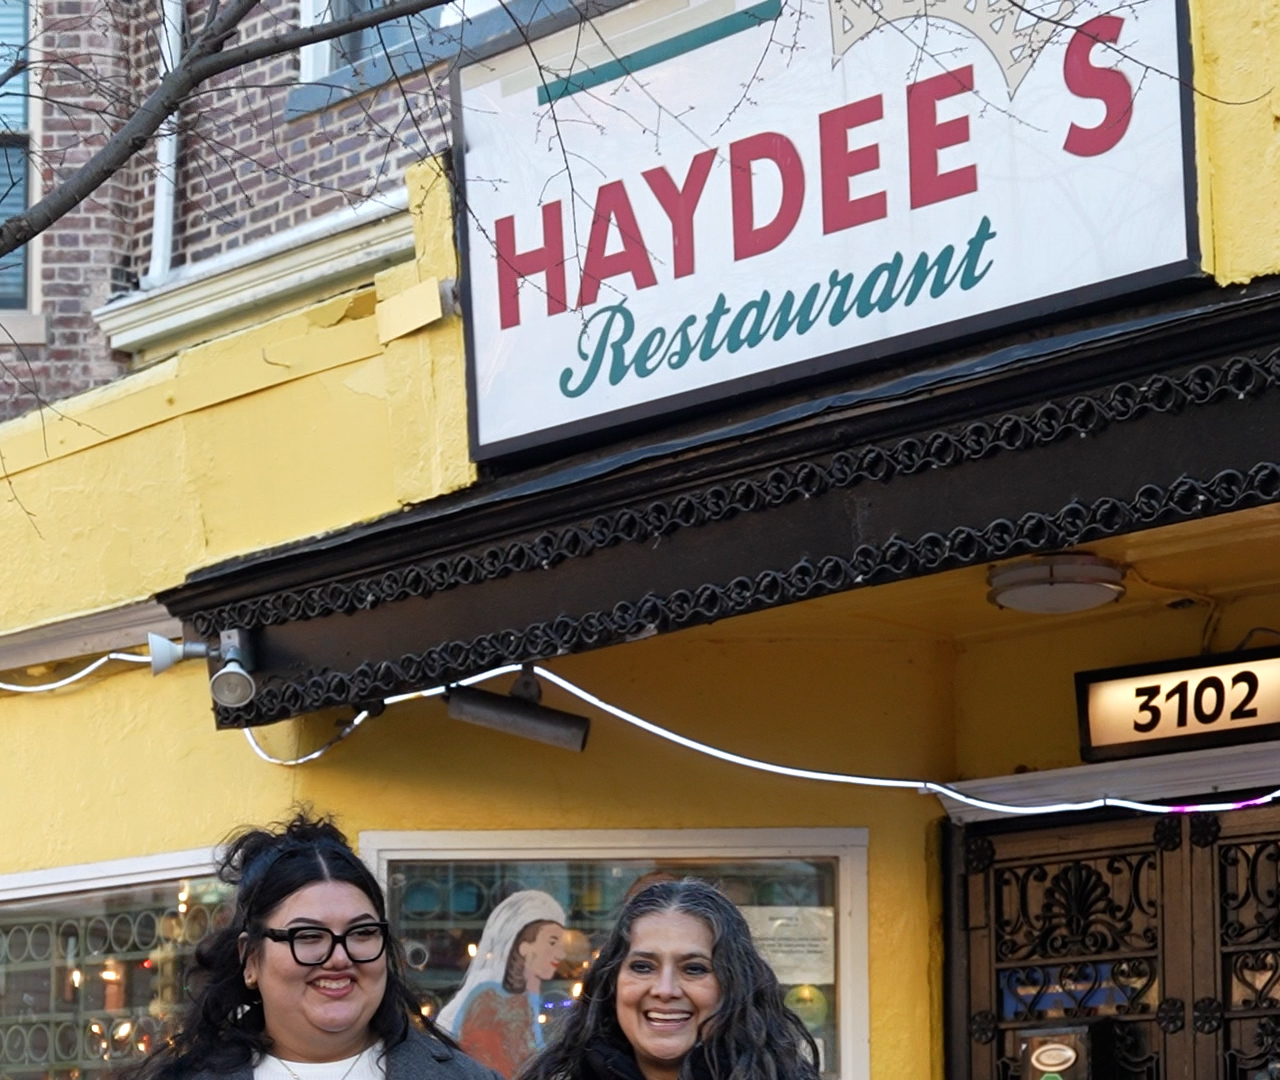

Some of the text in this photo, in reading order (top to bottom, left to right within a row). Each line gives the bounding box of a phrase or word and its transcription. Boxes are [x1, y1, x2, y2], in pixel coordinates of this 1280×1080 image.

[495, 66, 977, 330] HAYDEE
[558, 215, 997, 400] Restaurant
[1133, 670, 1259, 733] 3102
